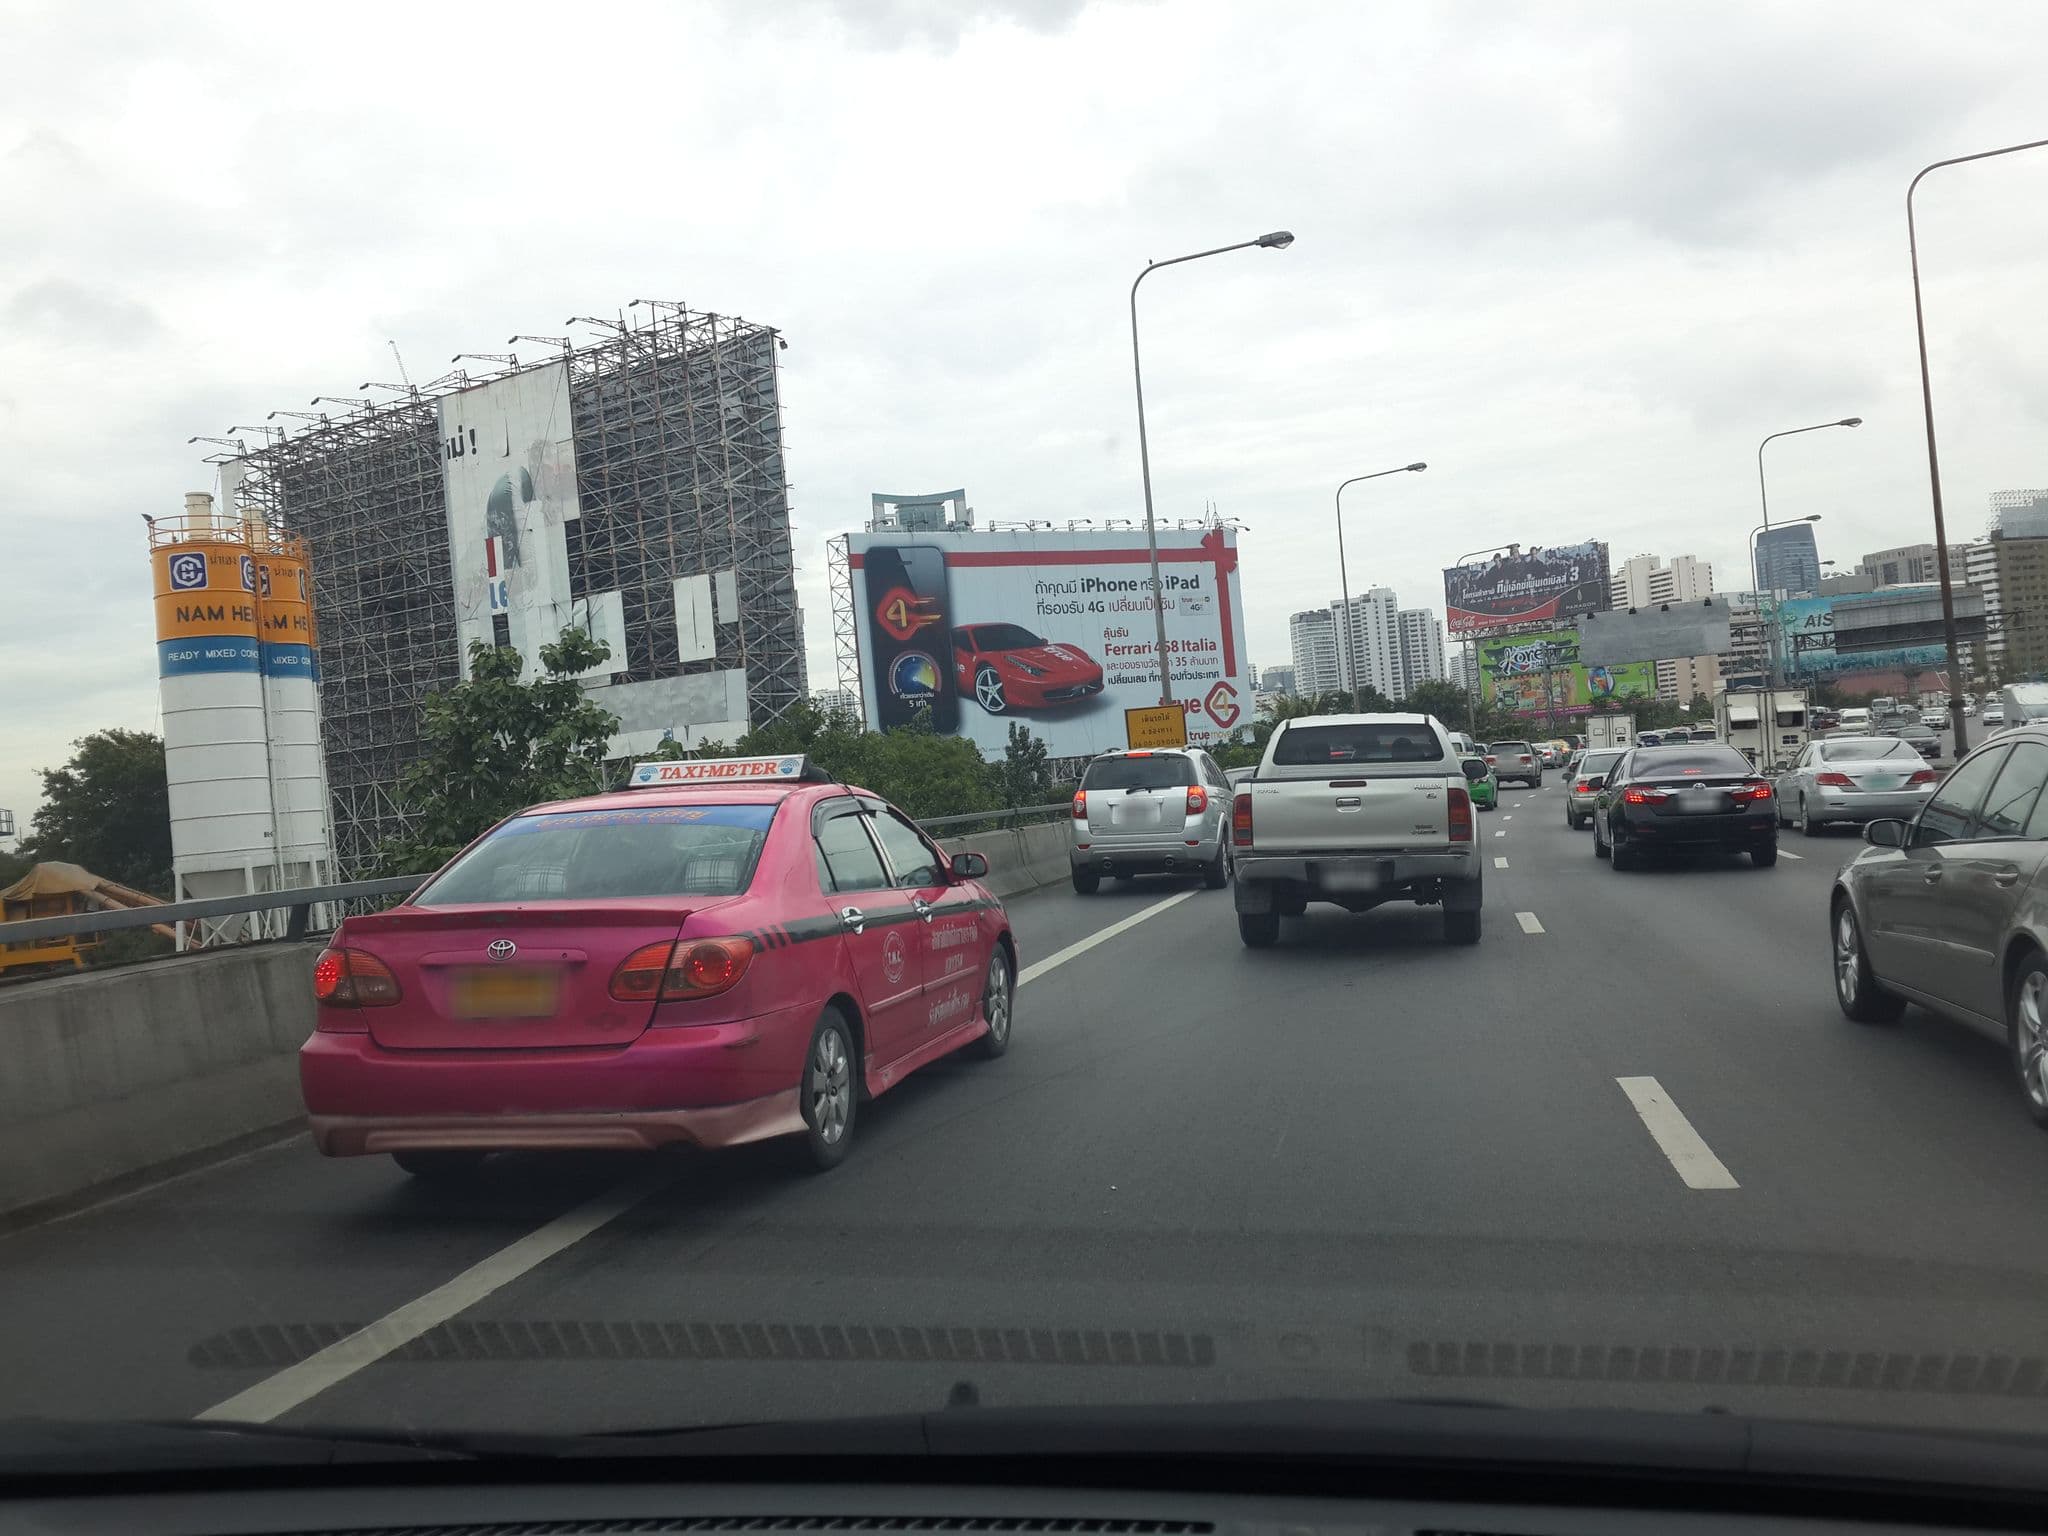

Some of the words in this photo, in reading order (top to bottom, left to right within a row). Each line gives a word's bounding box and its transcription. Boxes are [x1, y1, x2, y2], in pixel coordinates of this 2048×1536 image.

[1569, 566, 1580, 582] 3
[1081, 576, 1138, 593] iPhone
[1165, 575, 1201, 590] iPad
[176, 605, 224, 623] NAM
[1088, 601, 1105, 613] 4G
[1804, 612, 1833, 629] AIS
[168, 651, 200, 661] READY
[205, 649, 236, 659] MIXED
[1105, 641, 1151, 656] Ferrari
[1182, 638, 1217, 652] Italia
[1175, 656, 1187, 667] 35
[659, 762, 778, 780] TAXI-METER
